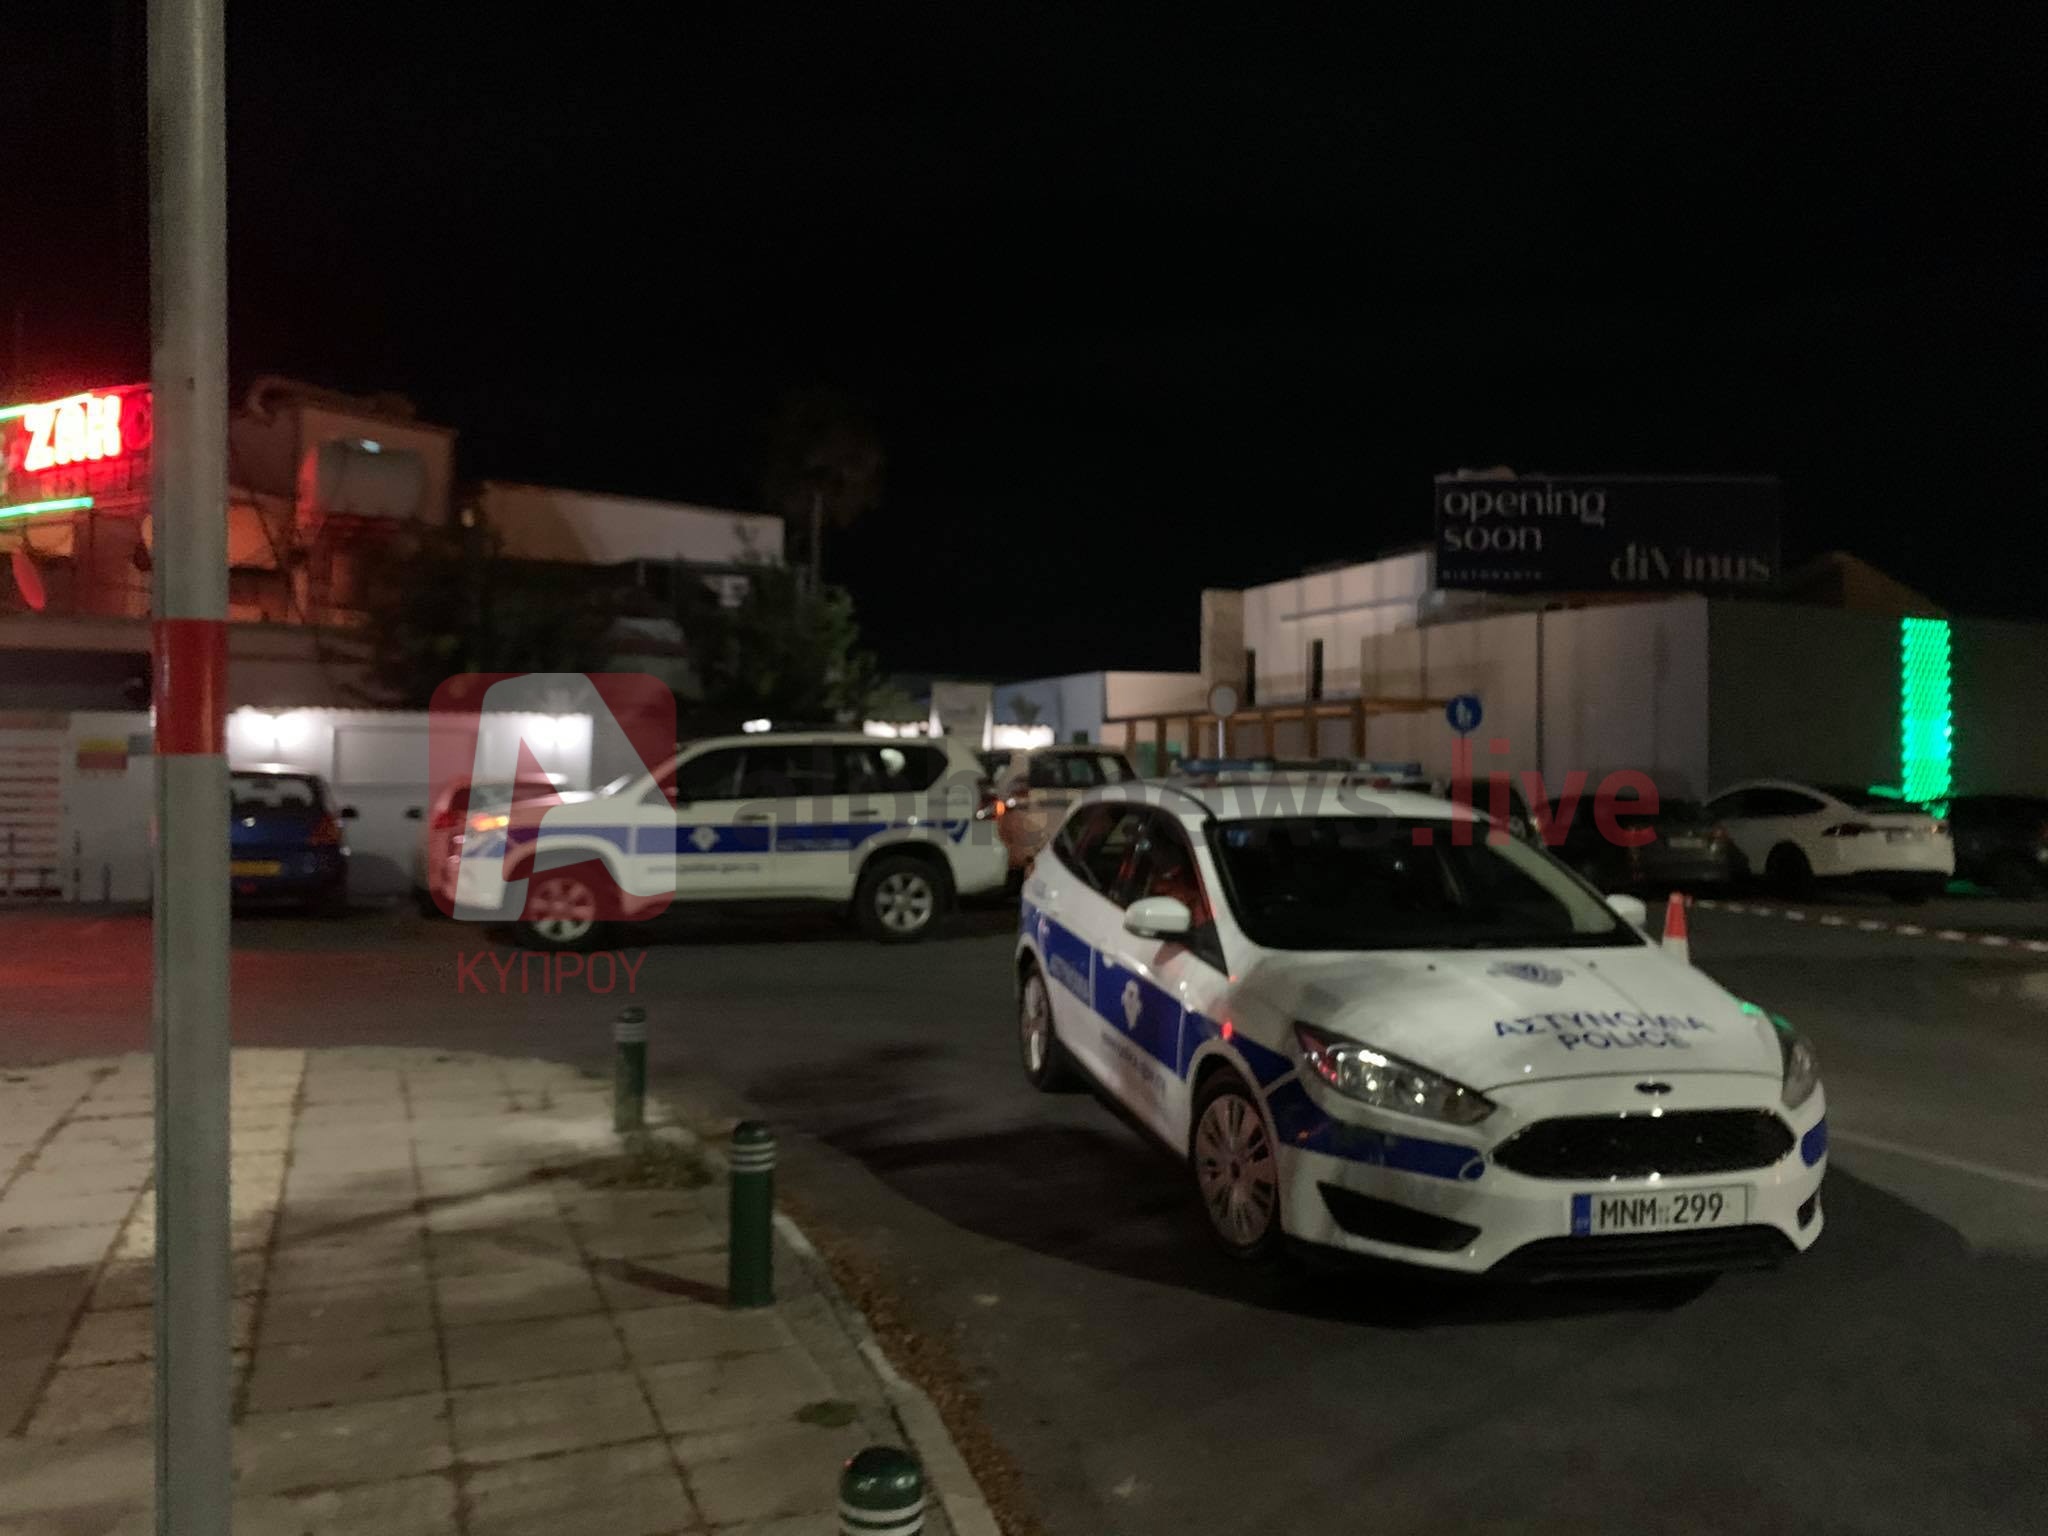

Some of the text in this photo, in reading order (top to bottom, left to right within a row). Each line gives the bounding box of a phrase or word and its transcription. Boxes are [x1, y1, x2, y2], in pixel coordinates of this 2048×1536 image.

[1443, 484, 1607, 528] opening
[1443, 525, 1543, 552] soon
[1557, 1030, 1691, 1051] POLICE
[1600, 1198, 1657, 1229] MNM
[1672, 1192, 1724, 1224] 299
